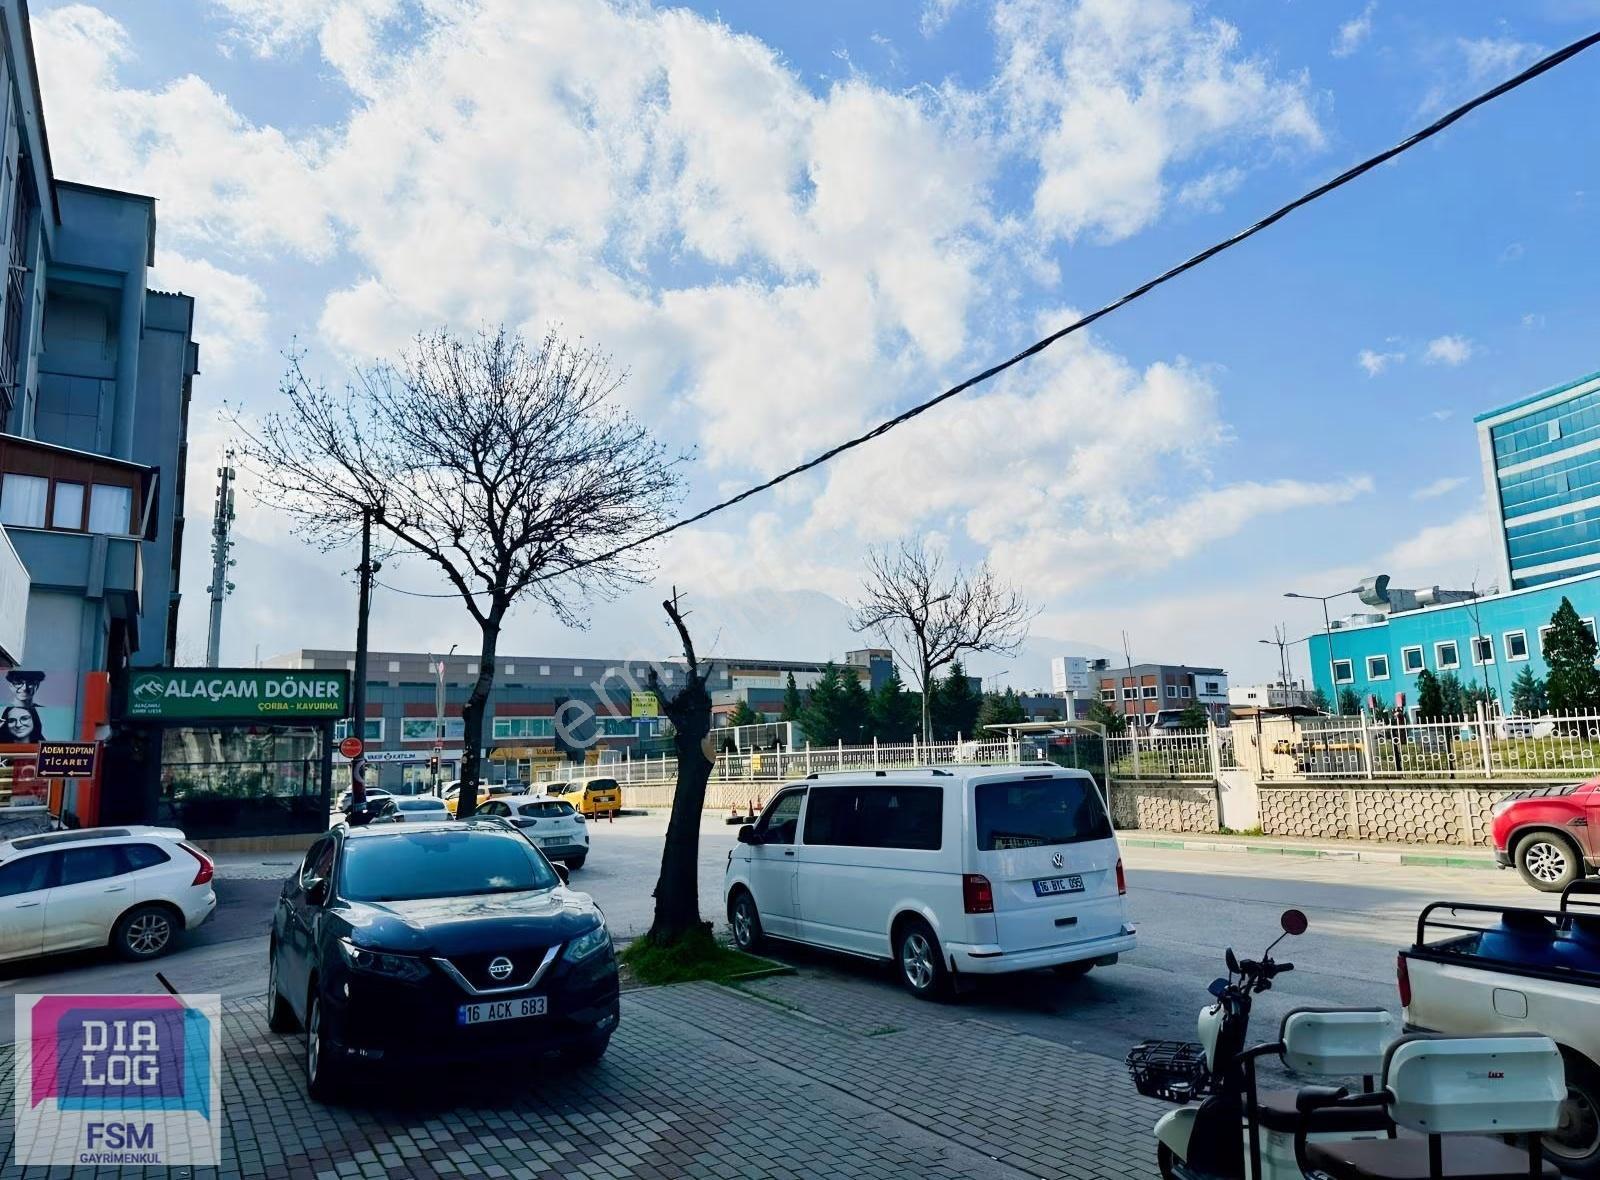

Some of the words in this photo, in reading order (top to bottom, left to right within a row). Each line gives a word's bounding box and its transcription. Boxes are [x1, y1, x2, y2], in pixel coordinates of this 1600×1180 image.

[164, 679, 258, 702] ALAÇAM
[265, 676, 340, 698] DÖNER
[258, 702, 289, 711] ÇORBA
[297, 702, 338, 710] KAVURMA
[42, 746, 64, 754] ADEM
[65, 746, 94, 755] TOPTAN
[45, 756, 89, 766] TİCARET
[466, 1005, 480, 1022] 16
[488, 1002, 513, 1019] ACK
[521, 998, 545, 1015] 683
